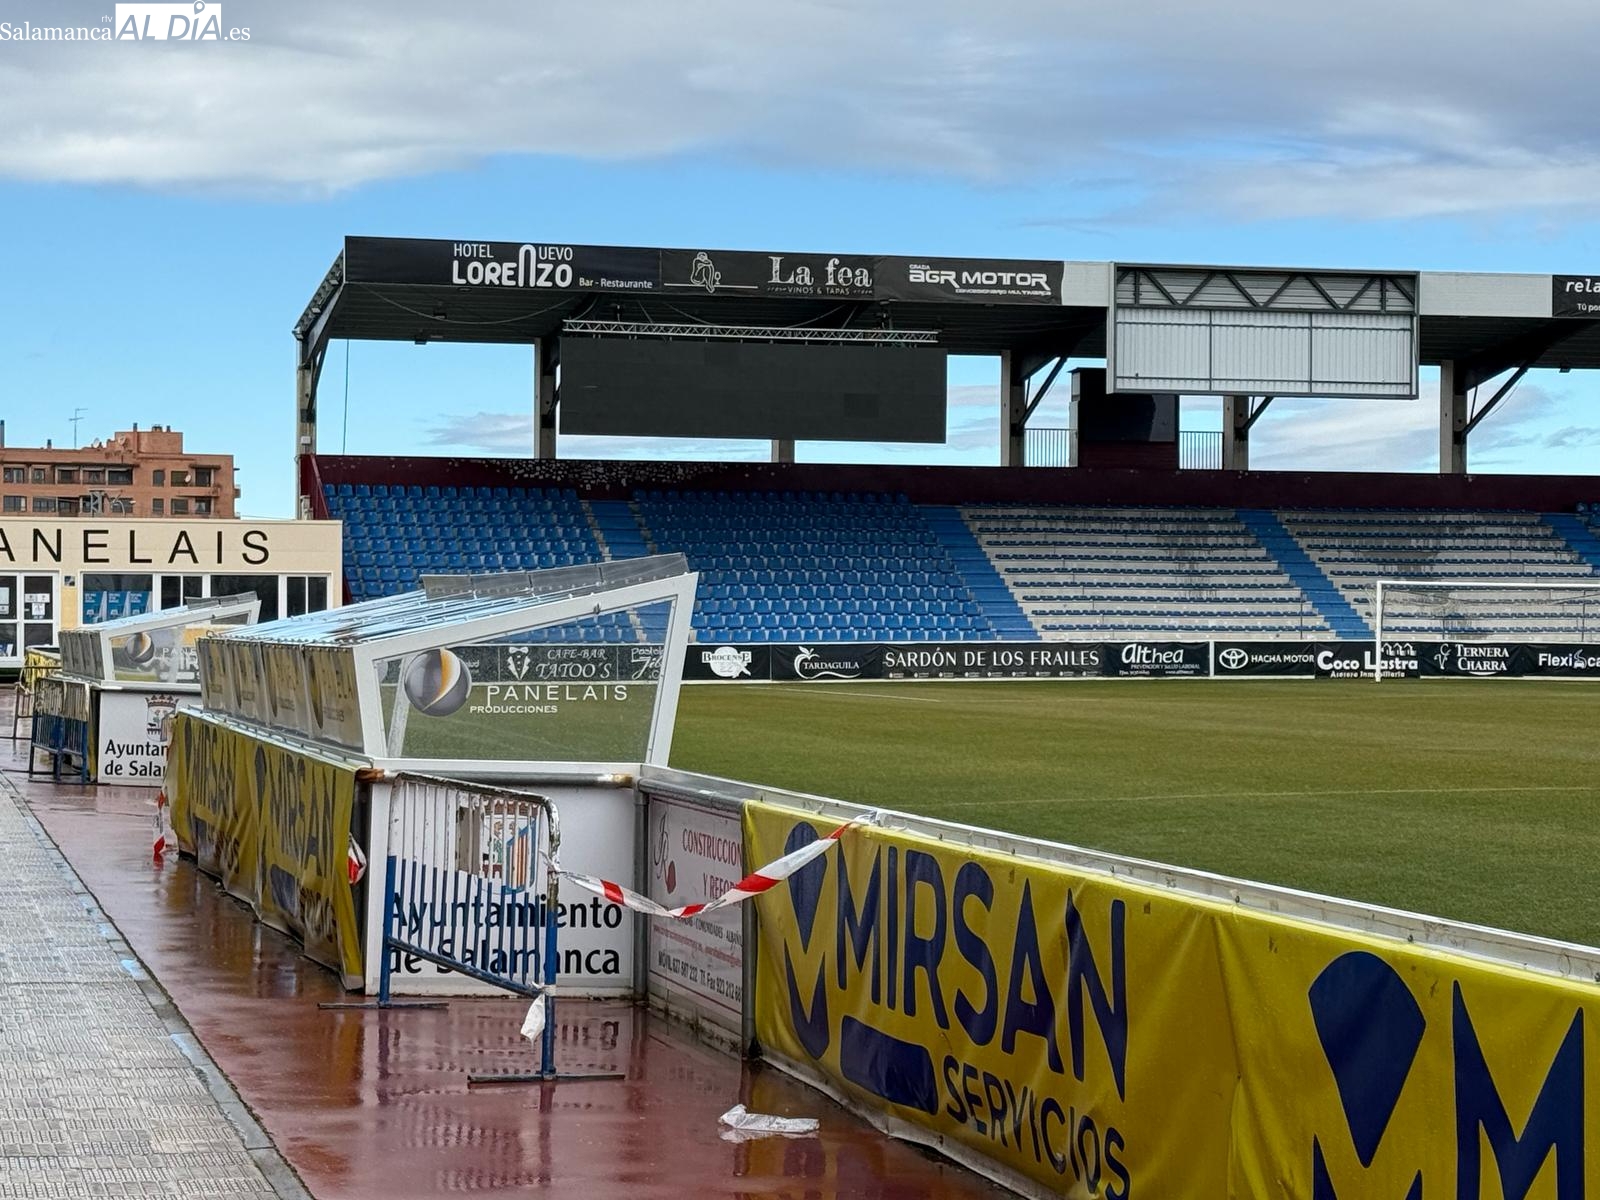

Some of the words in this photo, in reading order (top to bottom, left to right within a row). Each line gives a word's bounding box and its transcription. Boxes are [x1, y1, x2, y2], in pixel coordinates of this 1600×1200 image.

[453, 243, 494, 259] HOTEL
[452, 245, 573, 288] LORENZO
[767, 256, 815, 286] La
[824, 257, 873, 287] fea
[579, 277, 593, 287] Bar
[600, 278, 653, 290] Restaurante
[961, 271, 1052, 291] MOTOR
[787, 286, 814, 294] VINOS
[826, 287, 850, 295] TAPAS
[885, 647, 957, 667] SARDÓN
[964, 650, 987, 666] DE
[993, 650, 1024, 666] LOS
[1030, 650, 1100, 666] FRAILES
[1251, 654, 1282, 663] HACHA
[1284, 654, 1314, 663] MOTOR
[1455, 644, 1509, 657] TERNERA
[1317, 650, 1360, 670] Coco
[1364, 650, 1418, 670] Lastra
[1457, 658, 1507, 671] CHARRA
[487, 685, 628, 705] PANELAIS
[470, 705, 558, 714] PRODUCCIONES
[104, 760, 123, 776] de
[129, 760, 165, 777] Sala
[837, 838, 1129, 1103] MIRSAN
[943, 1054, 1131, 1200] SERVICIOS
